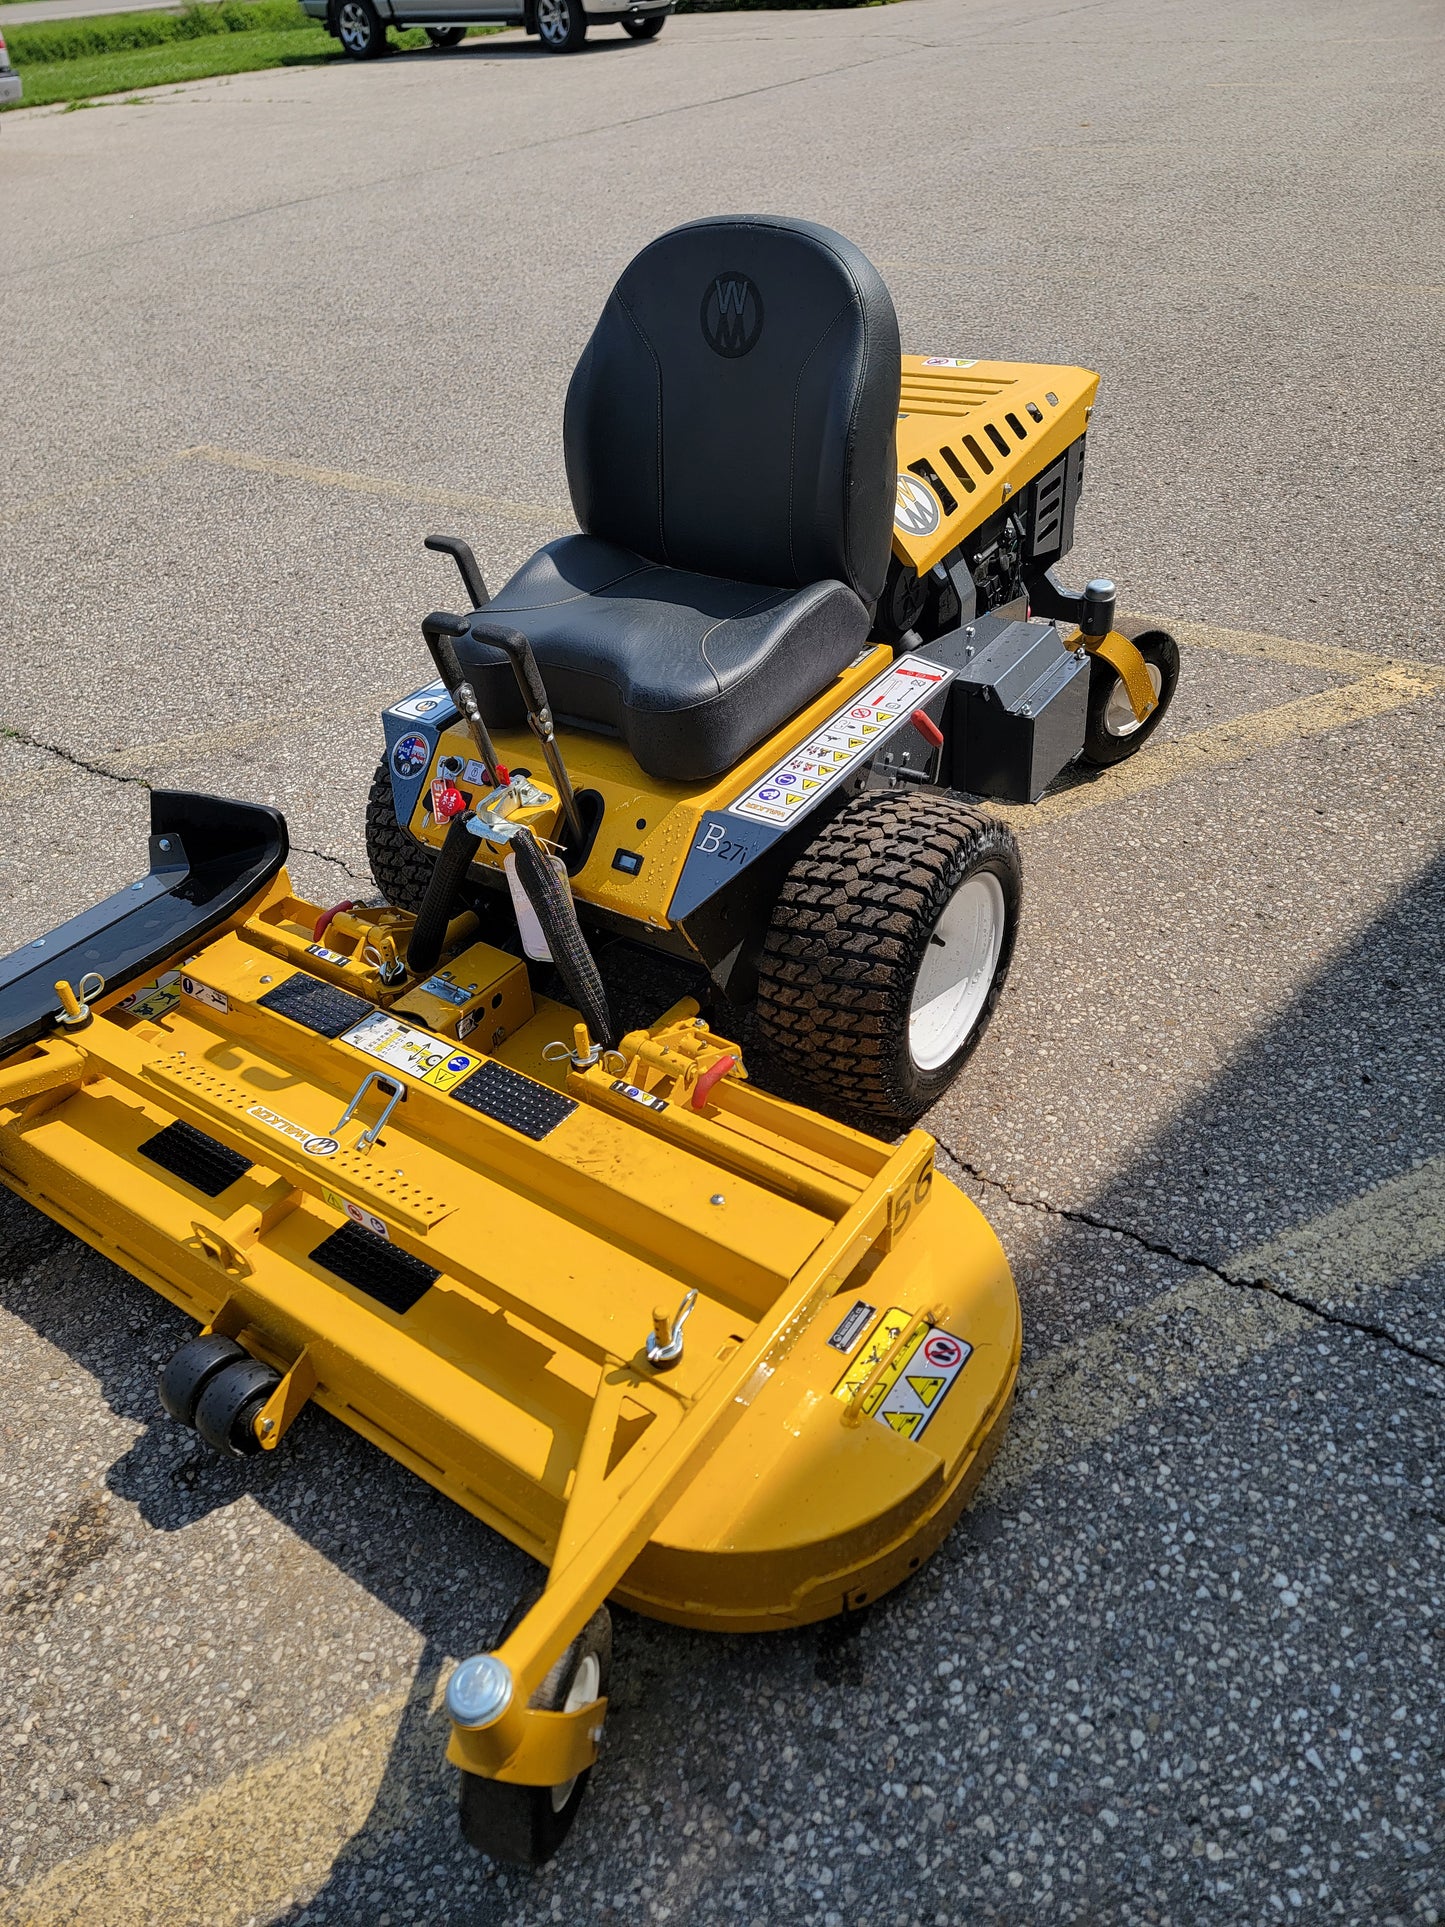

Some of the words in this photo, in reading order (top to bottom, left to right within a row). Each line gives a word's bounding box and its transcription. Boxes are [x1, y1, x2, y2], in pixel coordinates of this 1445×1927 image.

[695, 822, 749, 865] B27i
[251, 1107, 311, 1142] WALKER
[893, 1156, 933, 1237] 56
